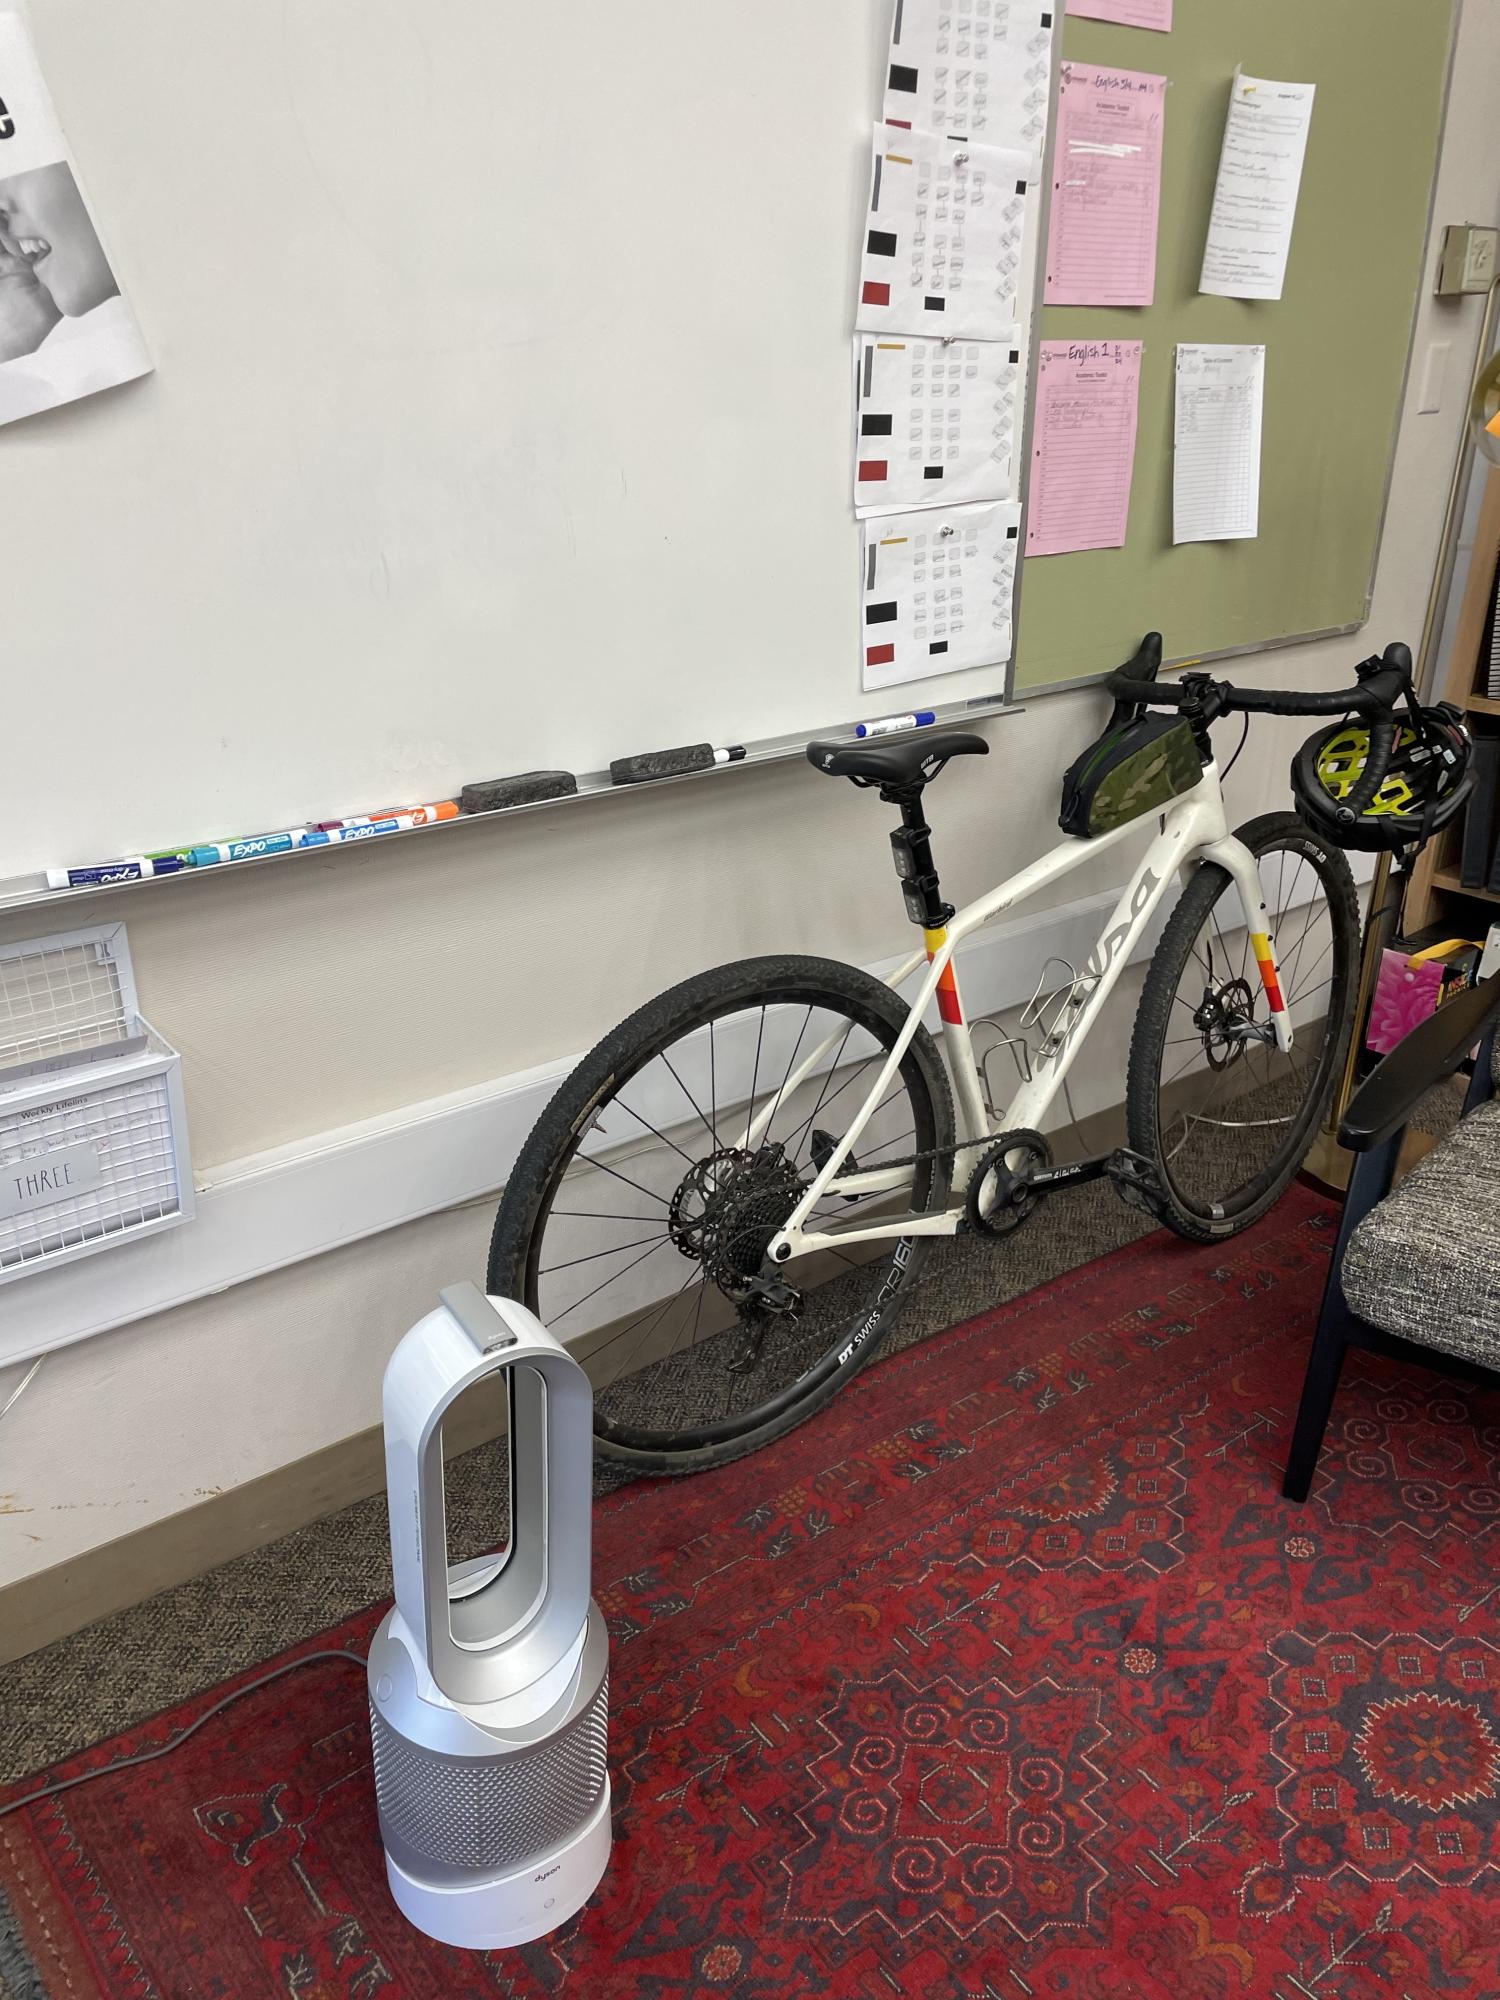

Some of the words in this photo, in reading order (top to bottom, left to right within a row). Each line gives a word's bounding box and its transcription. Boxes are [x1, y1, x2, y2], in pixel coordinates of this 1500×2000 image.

[1068, 344, 1099, 366] English
[1101, 342, 1109, 356] 1
[233, 840, 267, 858] EXPO
[101, 867, 139, 883] EXPO
[21, 1105, 54, 1120] Weekly
[13, 1162, 75, 1200] THREE
[838, 1343, 855, 1365] DT
[854, 1310, 881, 1346] SWISS
[534, 1865, 561, 1882] dyson
